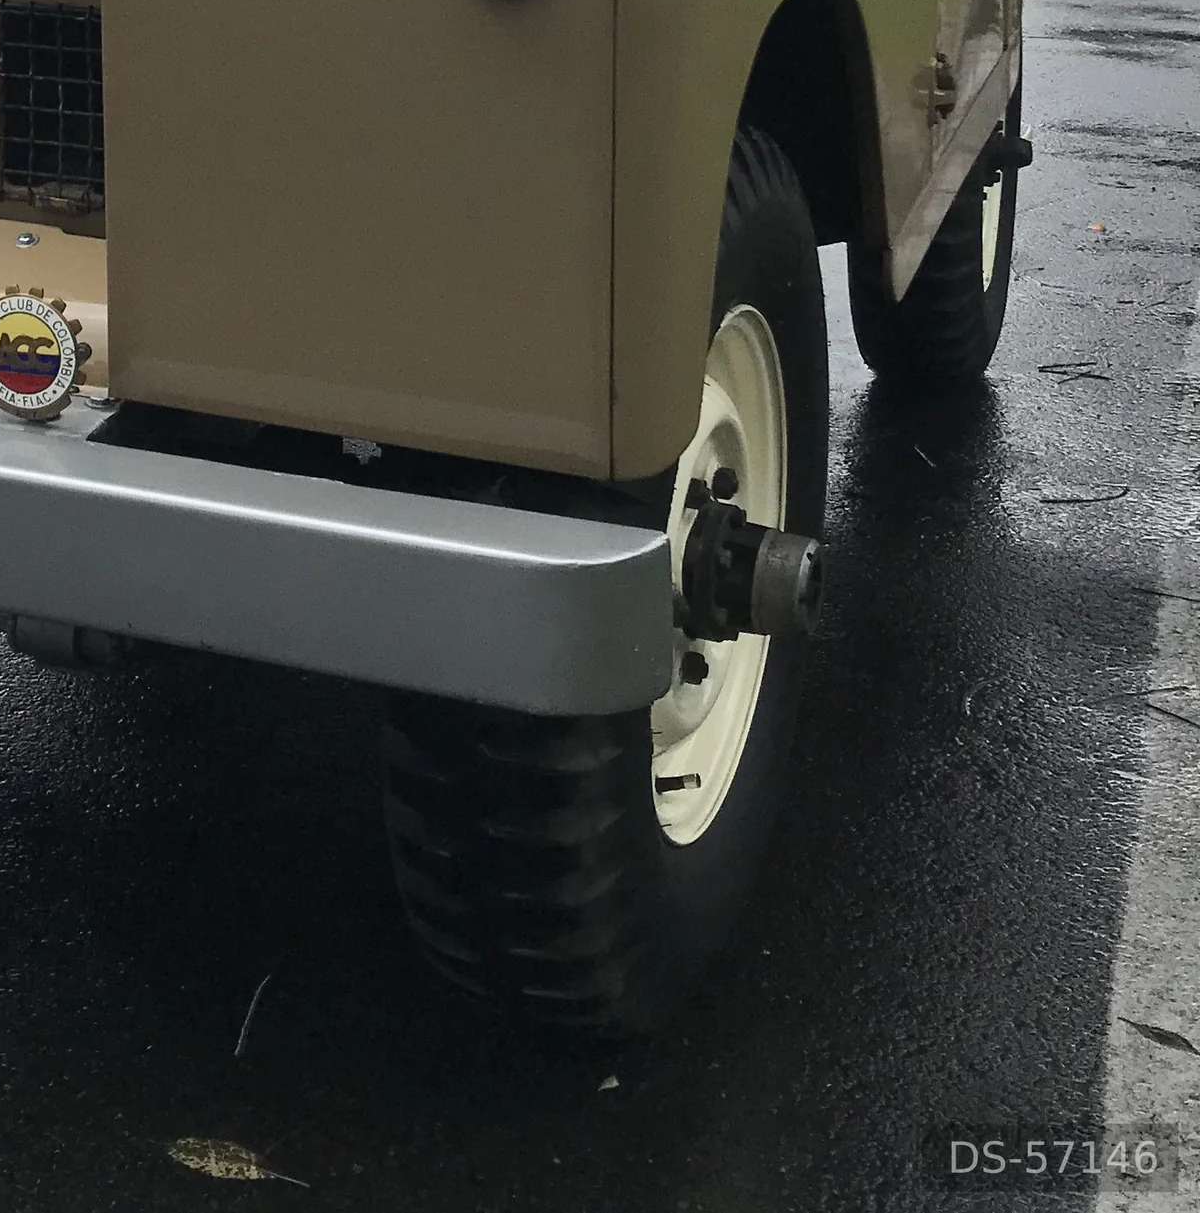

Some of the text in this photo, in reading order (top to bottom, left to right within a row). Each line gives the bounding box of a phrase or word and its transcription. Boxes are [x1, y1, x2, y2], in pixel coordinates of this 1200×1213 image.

[0, 298, 34, 312] CLUB
[36, 304, 54, 322] DE
[52, 320, 74, 390] COLOMBIA
